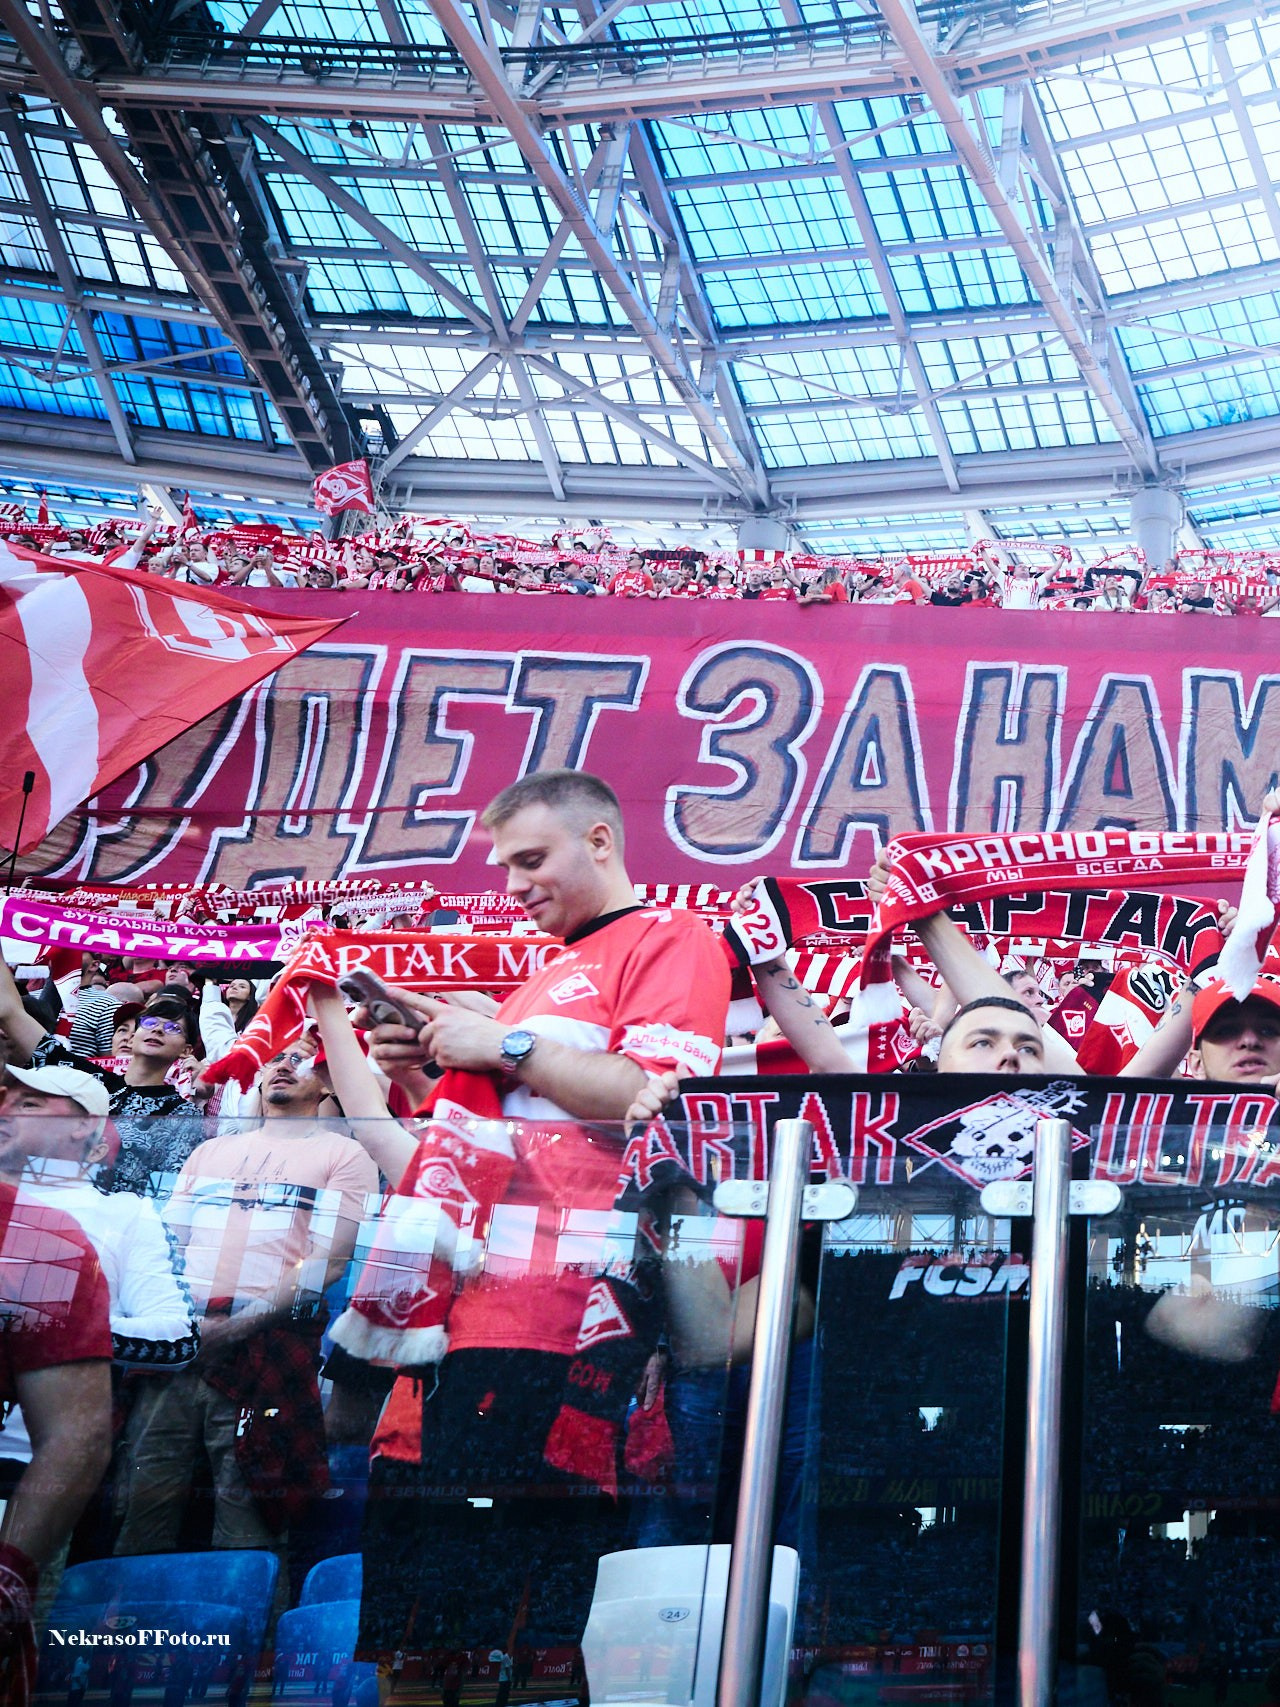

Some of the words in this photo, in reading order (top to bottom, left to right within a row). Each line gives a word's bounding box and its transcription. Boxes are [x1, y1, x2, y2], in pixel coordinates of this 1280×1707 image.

[10, 643, 651, 888] УДЕТ
[985, 868, 1024, 884] МЫ
[1076, 857, 1164, 875] ВСЕГДА
[440, 895, 497, 908] СПАРТАК
[11, 911, 271, 959] СПАРТАК
[62, 910, 178, 935] ФУТБОЛЬНЫЙ
[184, 925, 228, 938] КЛУБ
[797, 879, 1219, 968] САРТАК
[805, 937, 852, 946] WALK
[683, 1040, 714, 1066] Банк
[622, 1092, 902, 1189] ARTAK
[666, 1610, 681, 1620] 24
